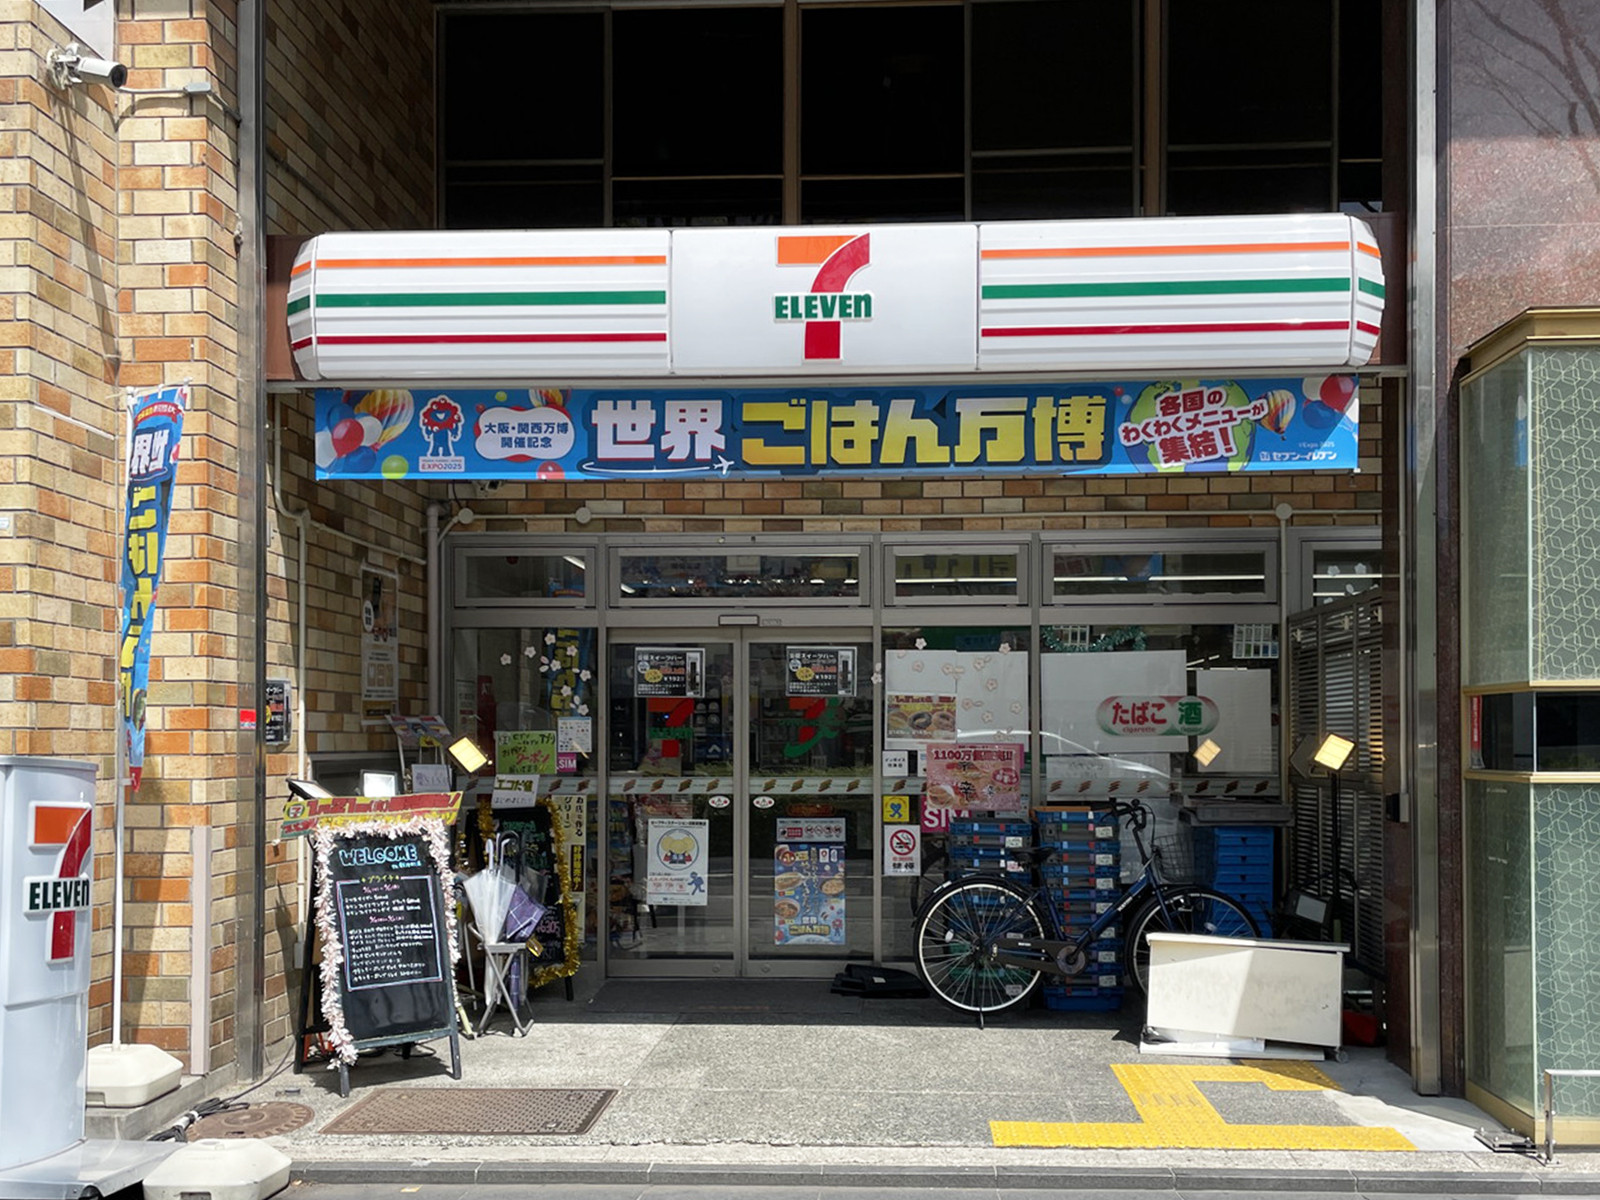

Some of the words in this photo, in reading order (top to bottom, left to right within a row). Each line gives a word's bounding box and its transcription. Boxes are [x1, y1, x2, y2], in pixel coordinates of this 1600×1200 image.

[777, 232, 870, 359] 7
[1159, 389, 1223, 418] 各国の
[484, 422, 569, 435] 大阪・関西万博
[589, 394, 1107, 465] 世界ごはん万博
[1122, 403, 1265, 443] わくわくメニューが
[501, 436, 552, 448] 開催記念
[1112, 701, 1167, 725] たばこ
[1178, 701, 1202, 725] 酒
[559, 759, 576, 769] SIM
[338, 843, 418, 867] WELCOME
[34, 805, 92, 960] 7
